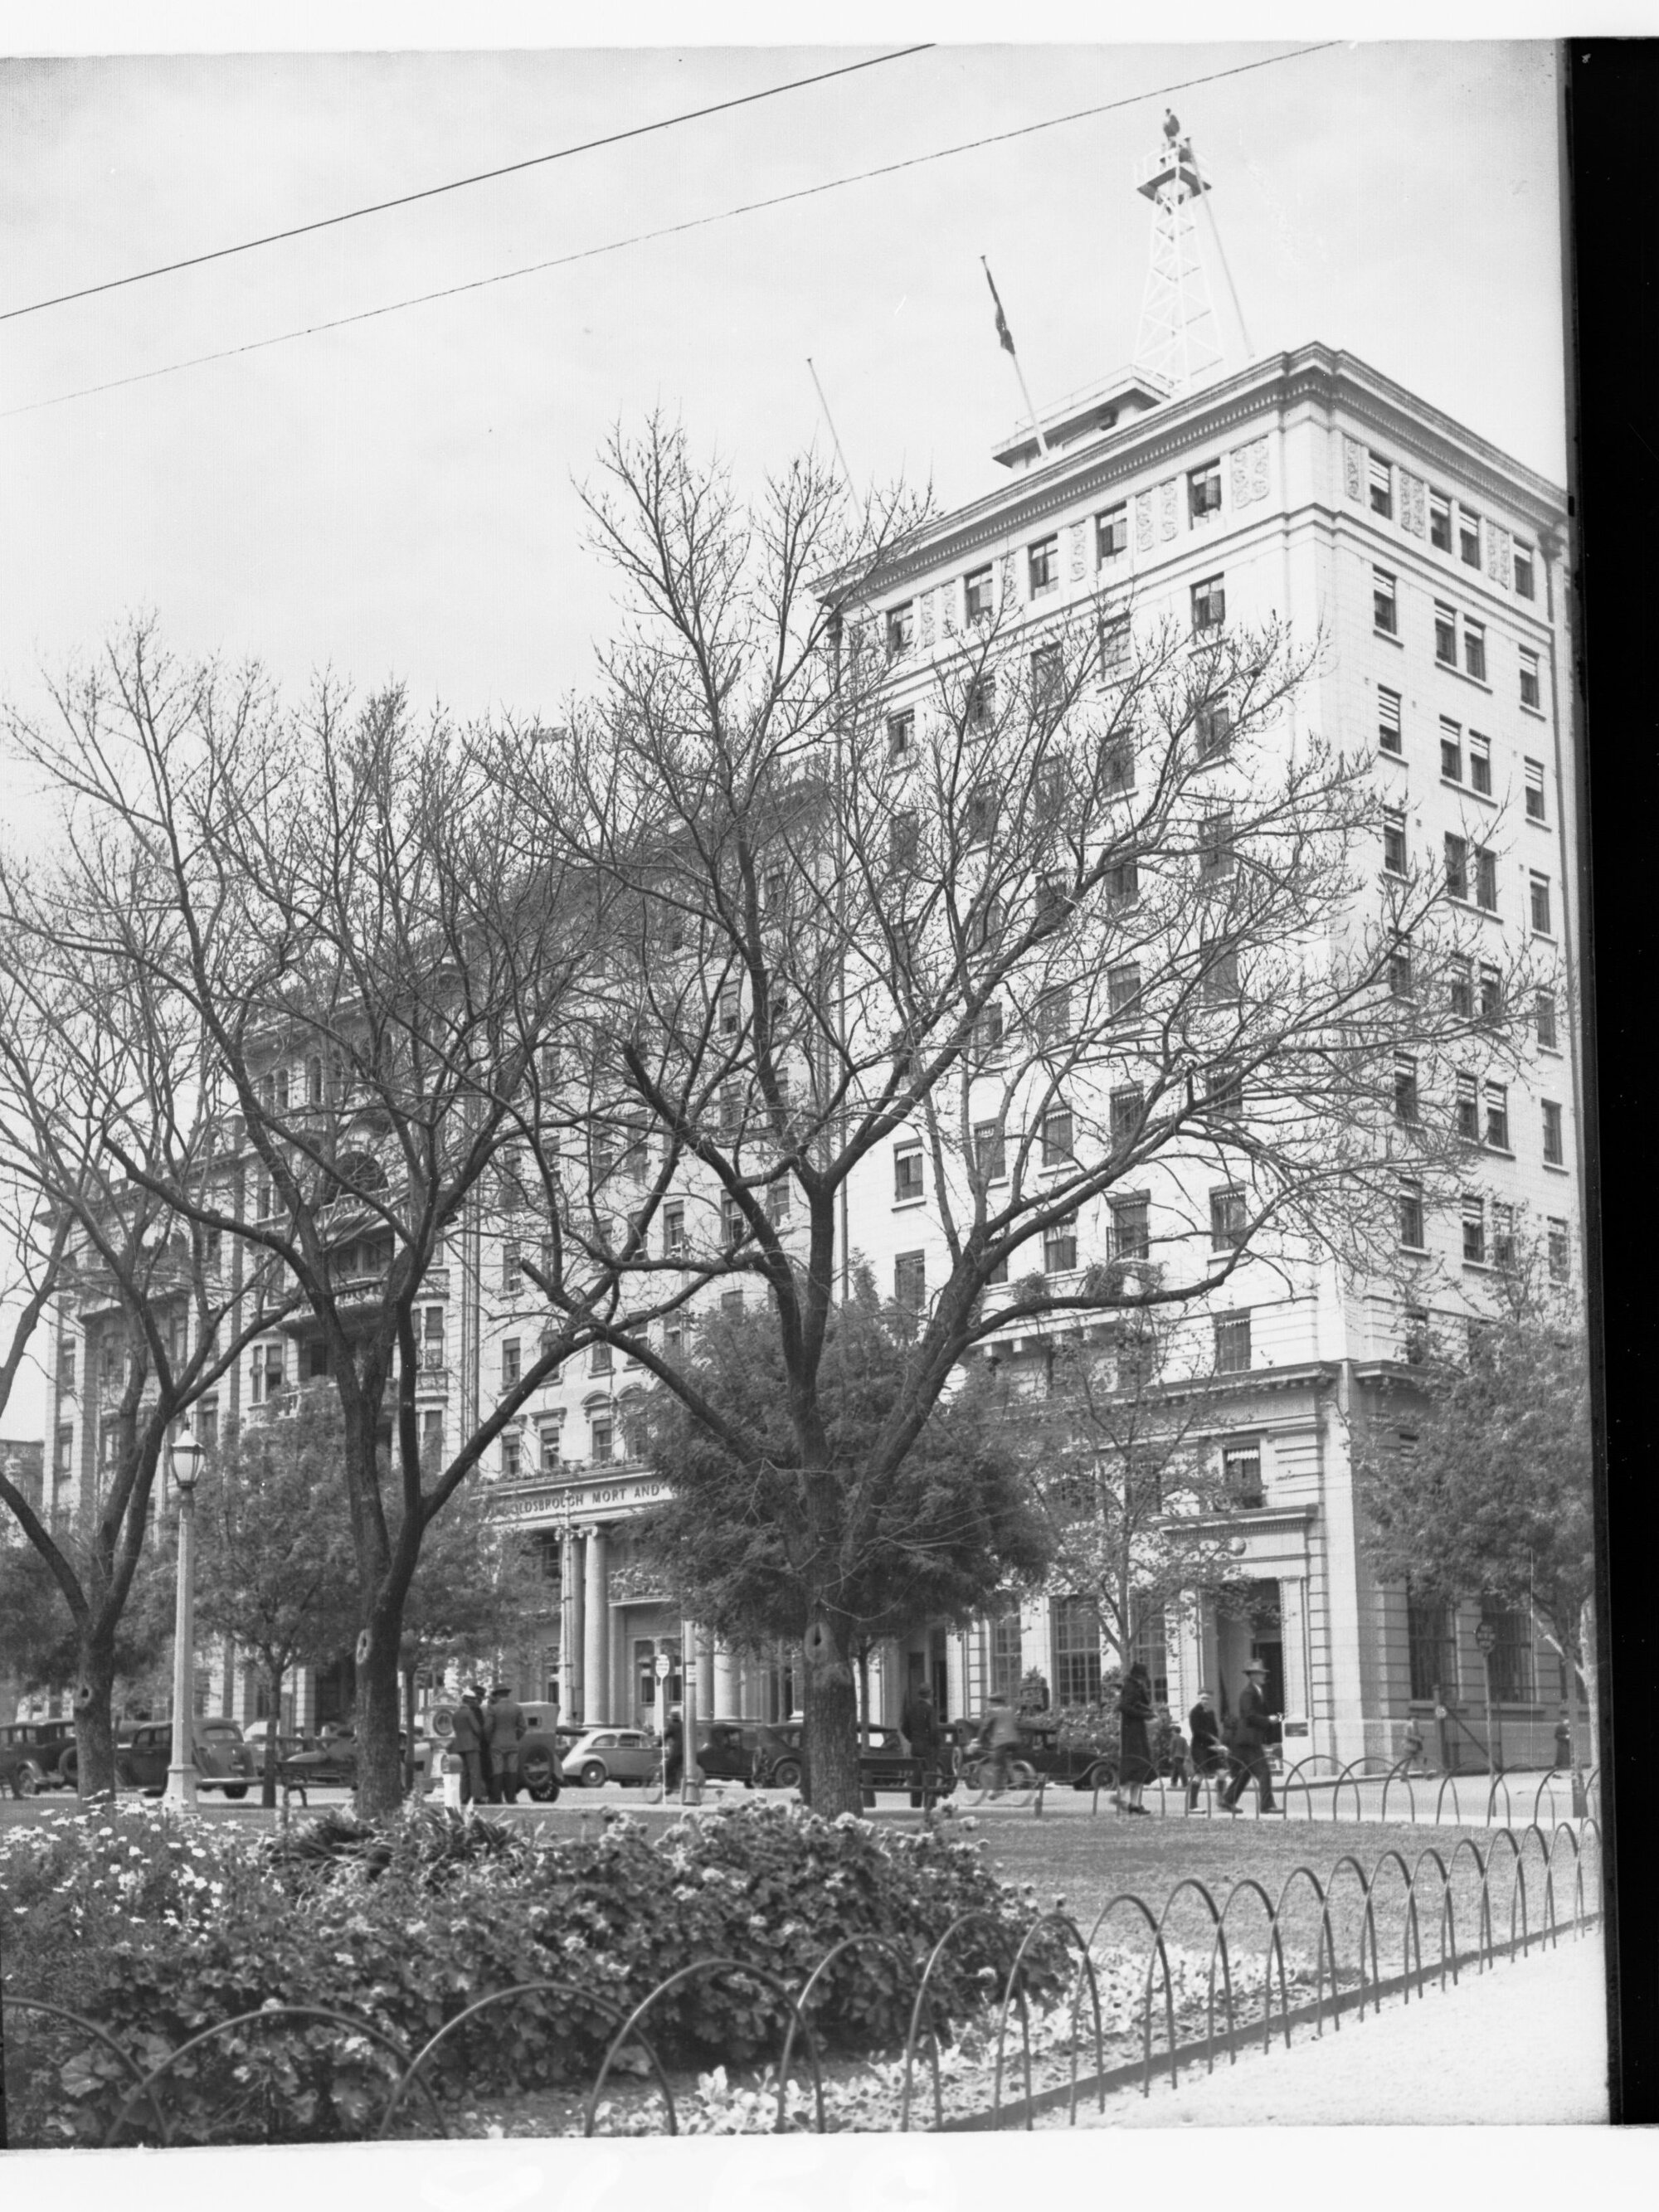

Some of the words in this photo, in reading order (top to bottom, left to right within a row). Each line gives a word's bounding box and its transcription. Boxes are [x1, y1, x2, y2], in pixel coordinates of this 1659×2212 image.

[504, 1493, 584, 1515] OLDSBROUGH
[591, 1487, 627, 1505] MORT
[635, 1483, 660, 1498] AND
